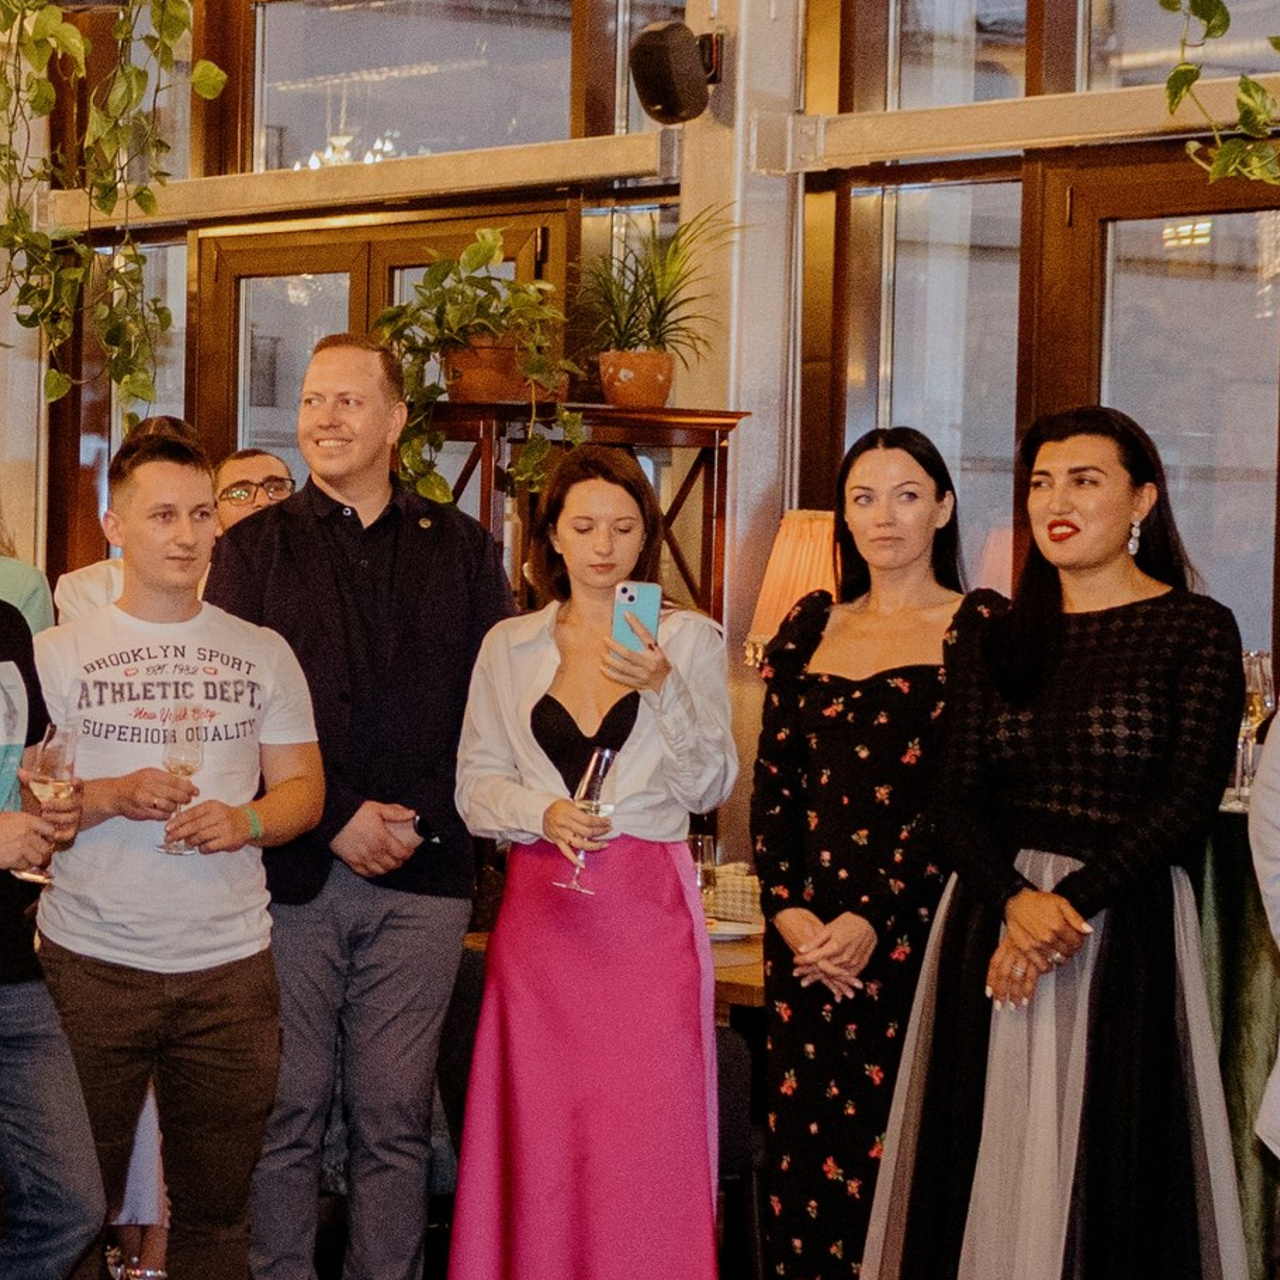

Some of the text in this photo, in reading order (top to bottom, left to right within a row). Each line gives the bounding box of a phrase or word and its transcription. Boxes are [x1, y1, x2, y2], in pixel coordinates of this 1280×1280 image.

[83, 645, 256, 675] BROOKLYN SPORT
[77, 680, 195, 711] ATHLETIC
